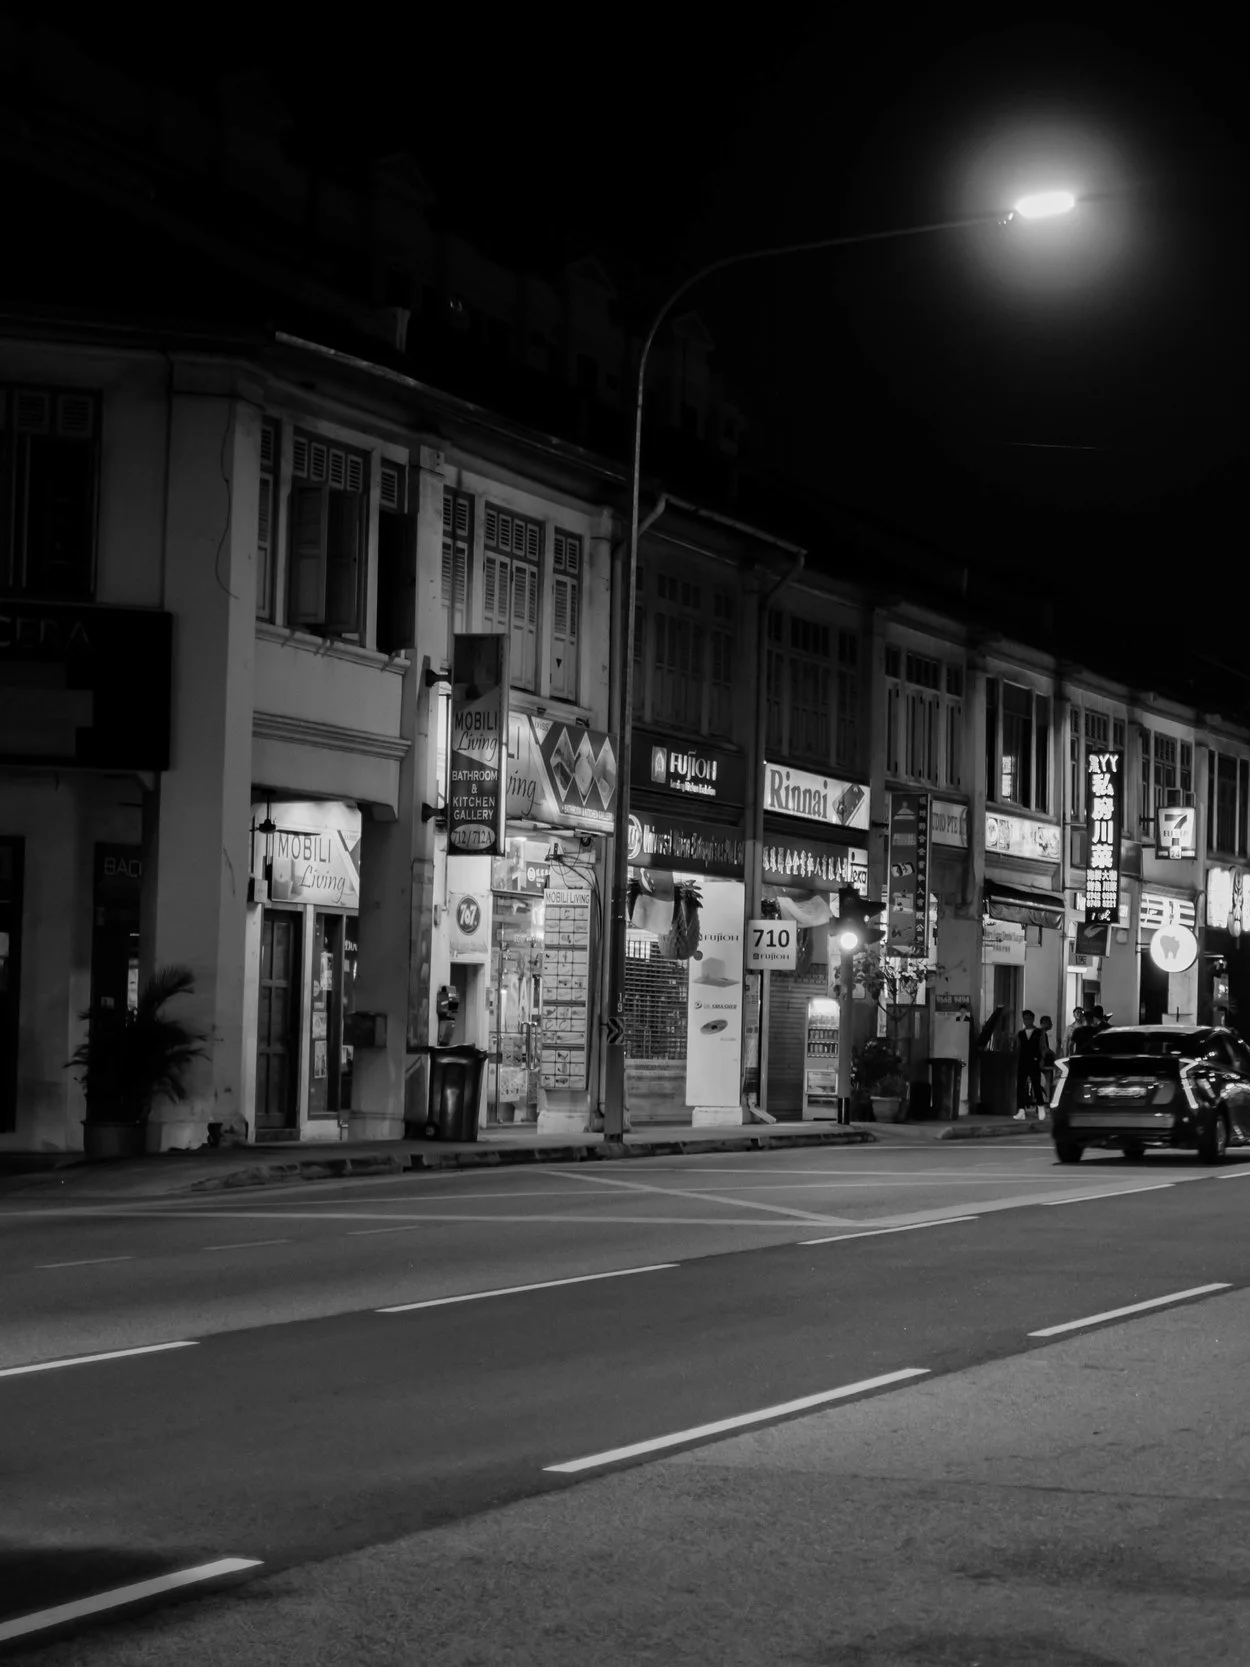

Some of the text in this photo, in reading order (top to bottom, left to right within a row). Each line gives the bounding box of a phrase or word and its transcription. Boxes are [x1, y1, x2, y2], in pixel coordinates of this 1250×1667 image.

[455, 711, 497, 731] MOBILI
[457, 731, 498, 762] Living
[452, 770, 498, 781] BATHROOM
[471, 783, 477, 794] &
[506, 770, 537, 817] ving
[770, 769, 828, 819] Rinnai
[453, 796, 496, 807] KITCHEN
[453, 809, 494, 820] GALLERY
[278, 832, 332, 863] MOBILI
[300, 864, 346, 905] Living
[752, 929, 790, 948] 710
